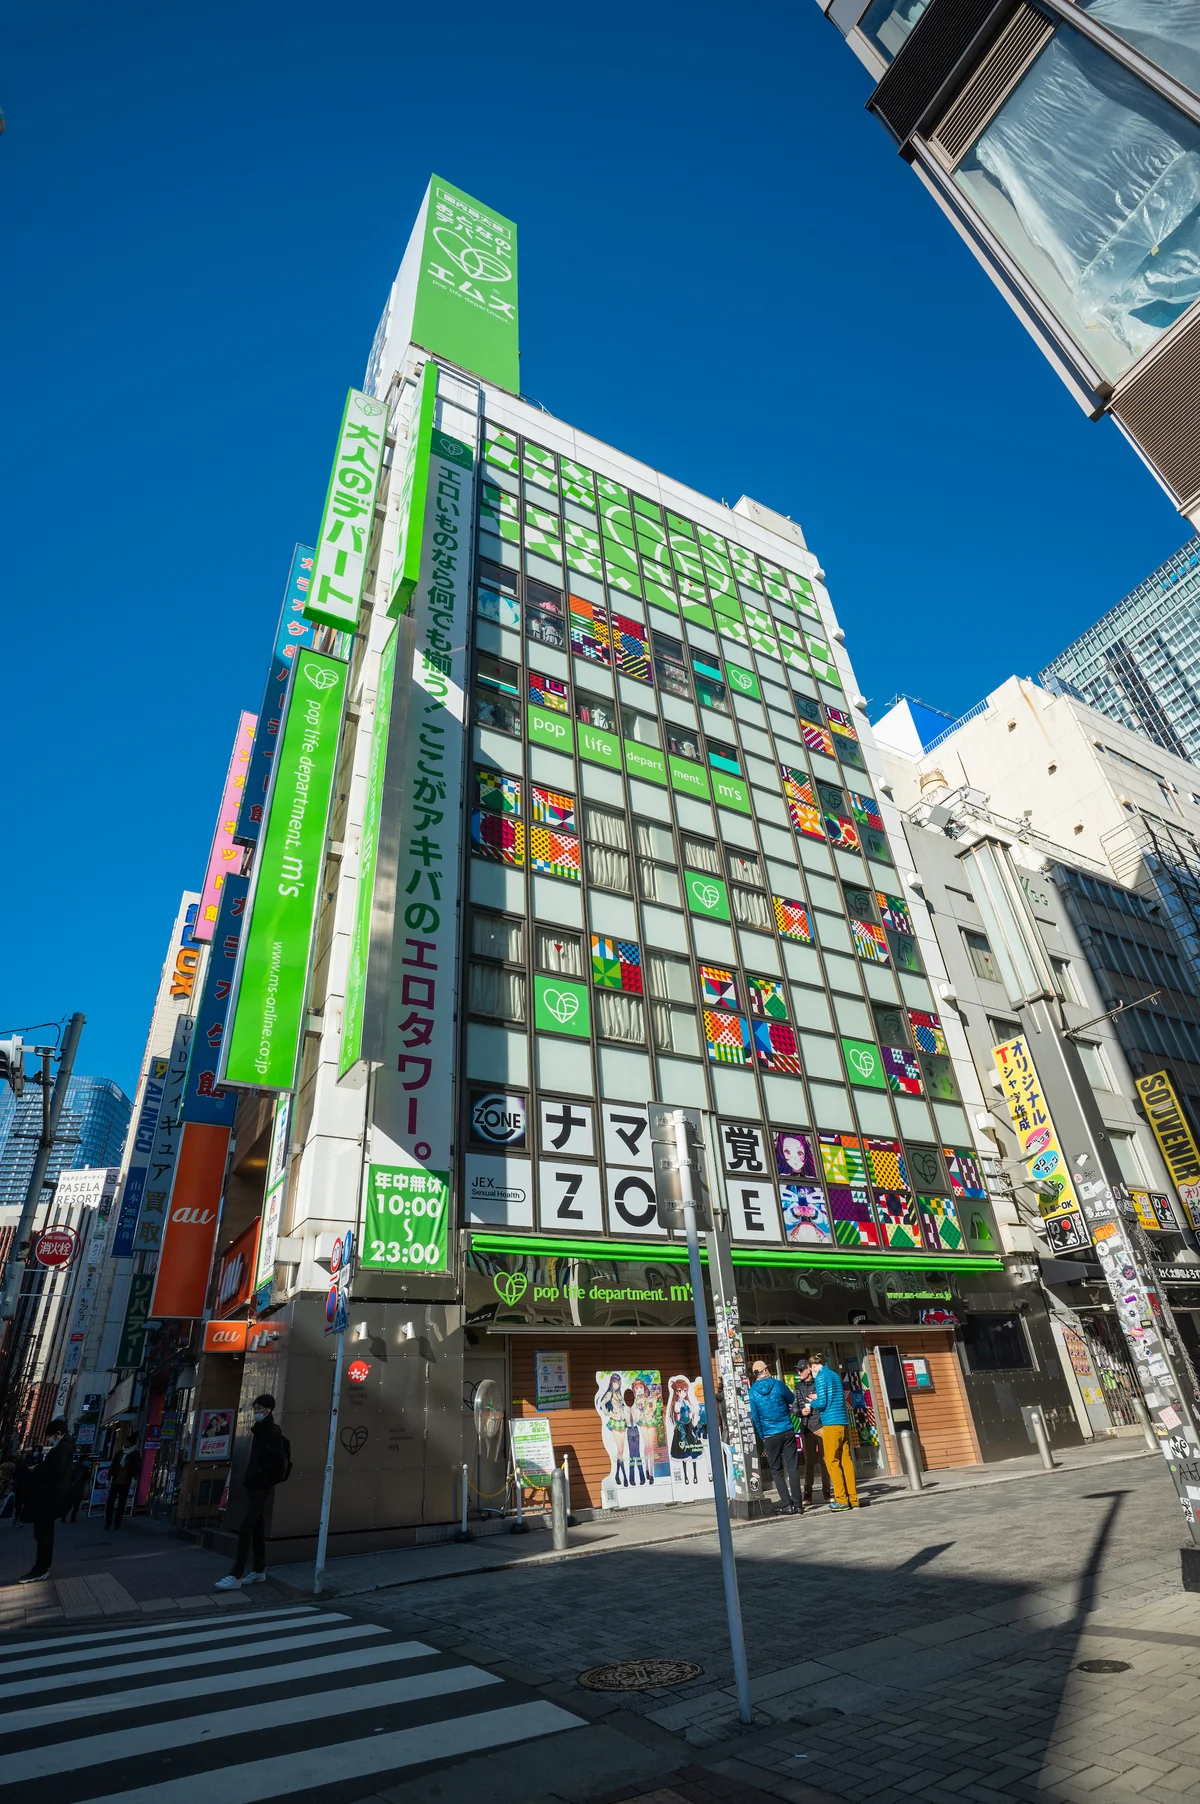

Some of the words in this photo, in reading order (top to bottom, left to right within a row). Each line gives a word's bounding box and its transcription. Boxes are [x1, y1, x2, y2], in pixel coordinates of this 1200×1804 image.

[428, 262, 516, 320] エムズ
[317, 422, 380, 604] 大人のデパート
[300, 698, 321, 730] pop
[300, 728, 321, 753] life
[534, 716, 566, 738] pop
[584, 734, 612, 756] life
[627, 751, 663, 772] depart
[674, 768, 704, 786] ment.
[718, 782, 742, 801] m's
[283, 752, 316, 850] department.
[278, 855, 304, 898] m's
[254, 941, 283, 1074] www.ms-online.co.jp
[996, 1046, 1030, 1131] Tシャツ作成
[1011, 1040, 1046, 1126] オリジナル
[136, 1080, 164, 1154] ALINCO
[474, 1108, 521, 1129] ZONE
[1140, 1074, 1200, 1181] SOUVENIR
[58, 1182, 100, 1192] PASELA
[374, 1172, 444, 1194] 年中無休
[472, 1176, 494, 1188] JEX
[472, 1188, 496, 1197] Sexual
[496, 1190, 520, 1199] Health
[376, 1194, 441, 1218] 10:00
[556, 1172, 764, 1232] ZOE
[172, 1207, 216, 1225] au
[38, 1241, 72, 1256] 消火栓
[370, 1240, 439, 1264] 23:00
[534, 1286, 560, 1302] pop
[564, 1284, 586, 1300] life
[592, 1285, 668, 1303] department.
[886, 1290, 952, 1300] www.ms-online.co.jp
[212, 1330, 240, 1342] au
[90, 1395, 97, 1404] P
